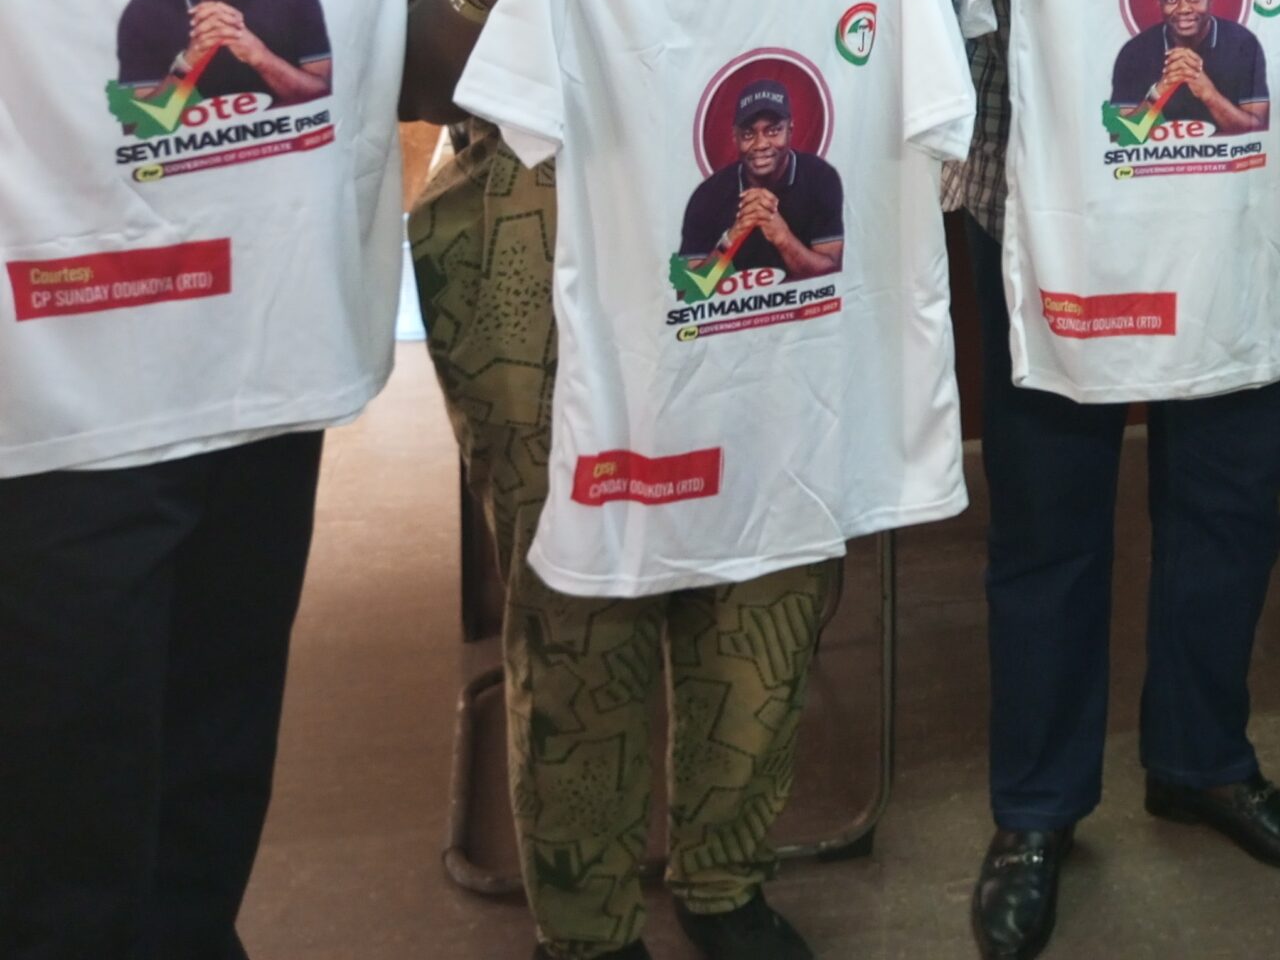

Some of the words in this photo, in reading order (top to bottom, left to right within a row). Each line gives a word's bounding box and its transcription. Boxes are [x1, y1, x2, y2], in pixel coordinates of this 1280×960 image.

[116, 138, 171, 164] SEYI
[175, 117, 291, 154] MAKINDE
[1104, 147, 1140, 165] SEYI
[1143, 144, 1229, 161] MAKINDE
[32, 290, 51, 308] CP
[55, 284, 111, 307] SUNDAY
[112, 276, 174, 300] ODUKOYA
[176, 270, 214, 292] (RTD)
[666, 302, 706, 325] SEYI
[708, 289, 798, 317] MAKINDE
[799, 284, 836, 304] (FNSE)
[1056, 316, 1092, 331] SUNDAY
[1135, 315, 1162, 329] (RTD)
[676, 477, 705, 495] (RTD)
